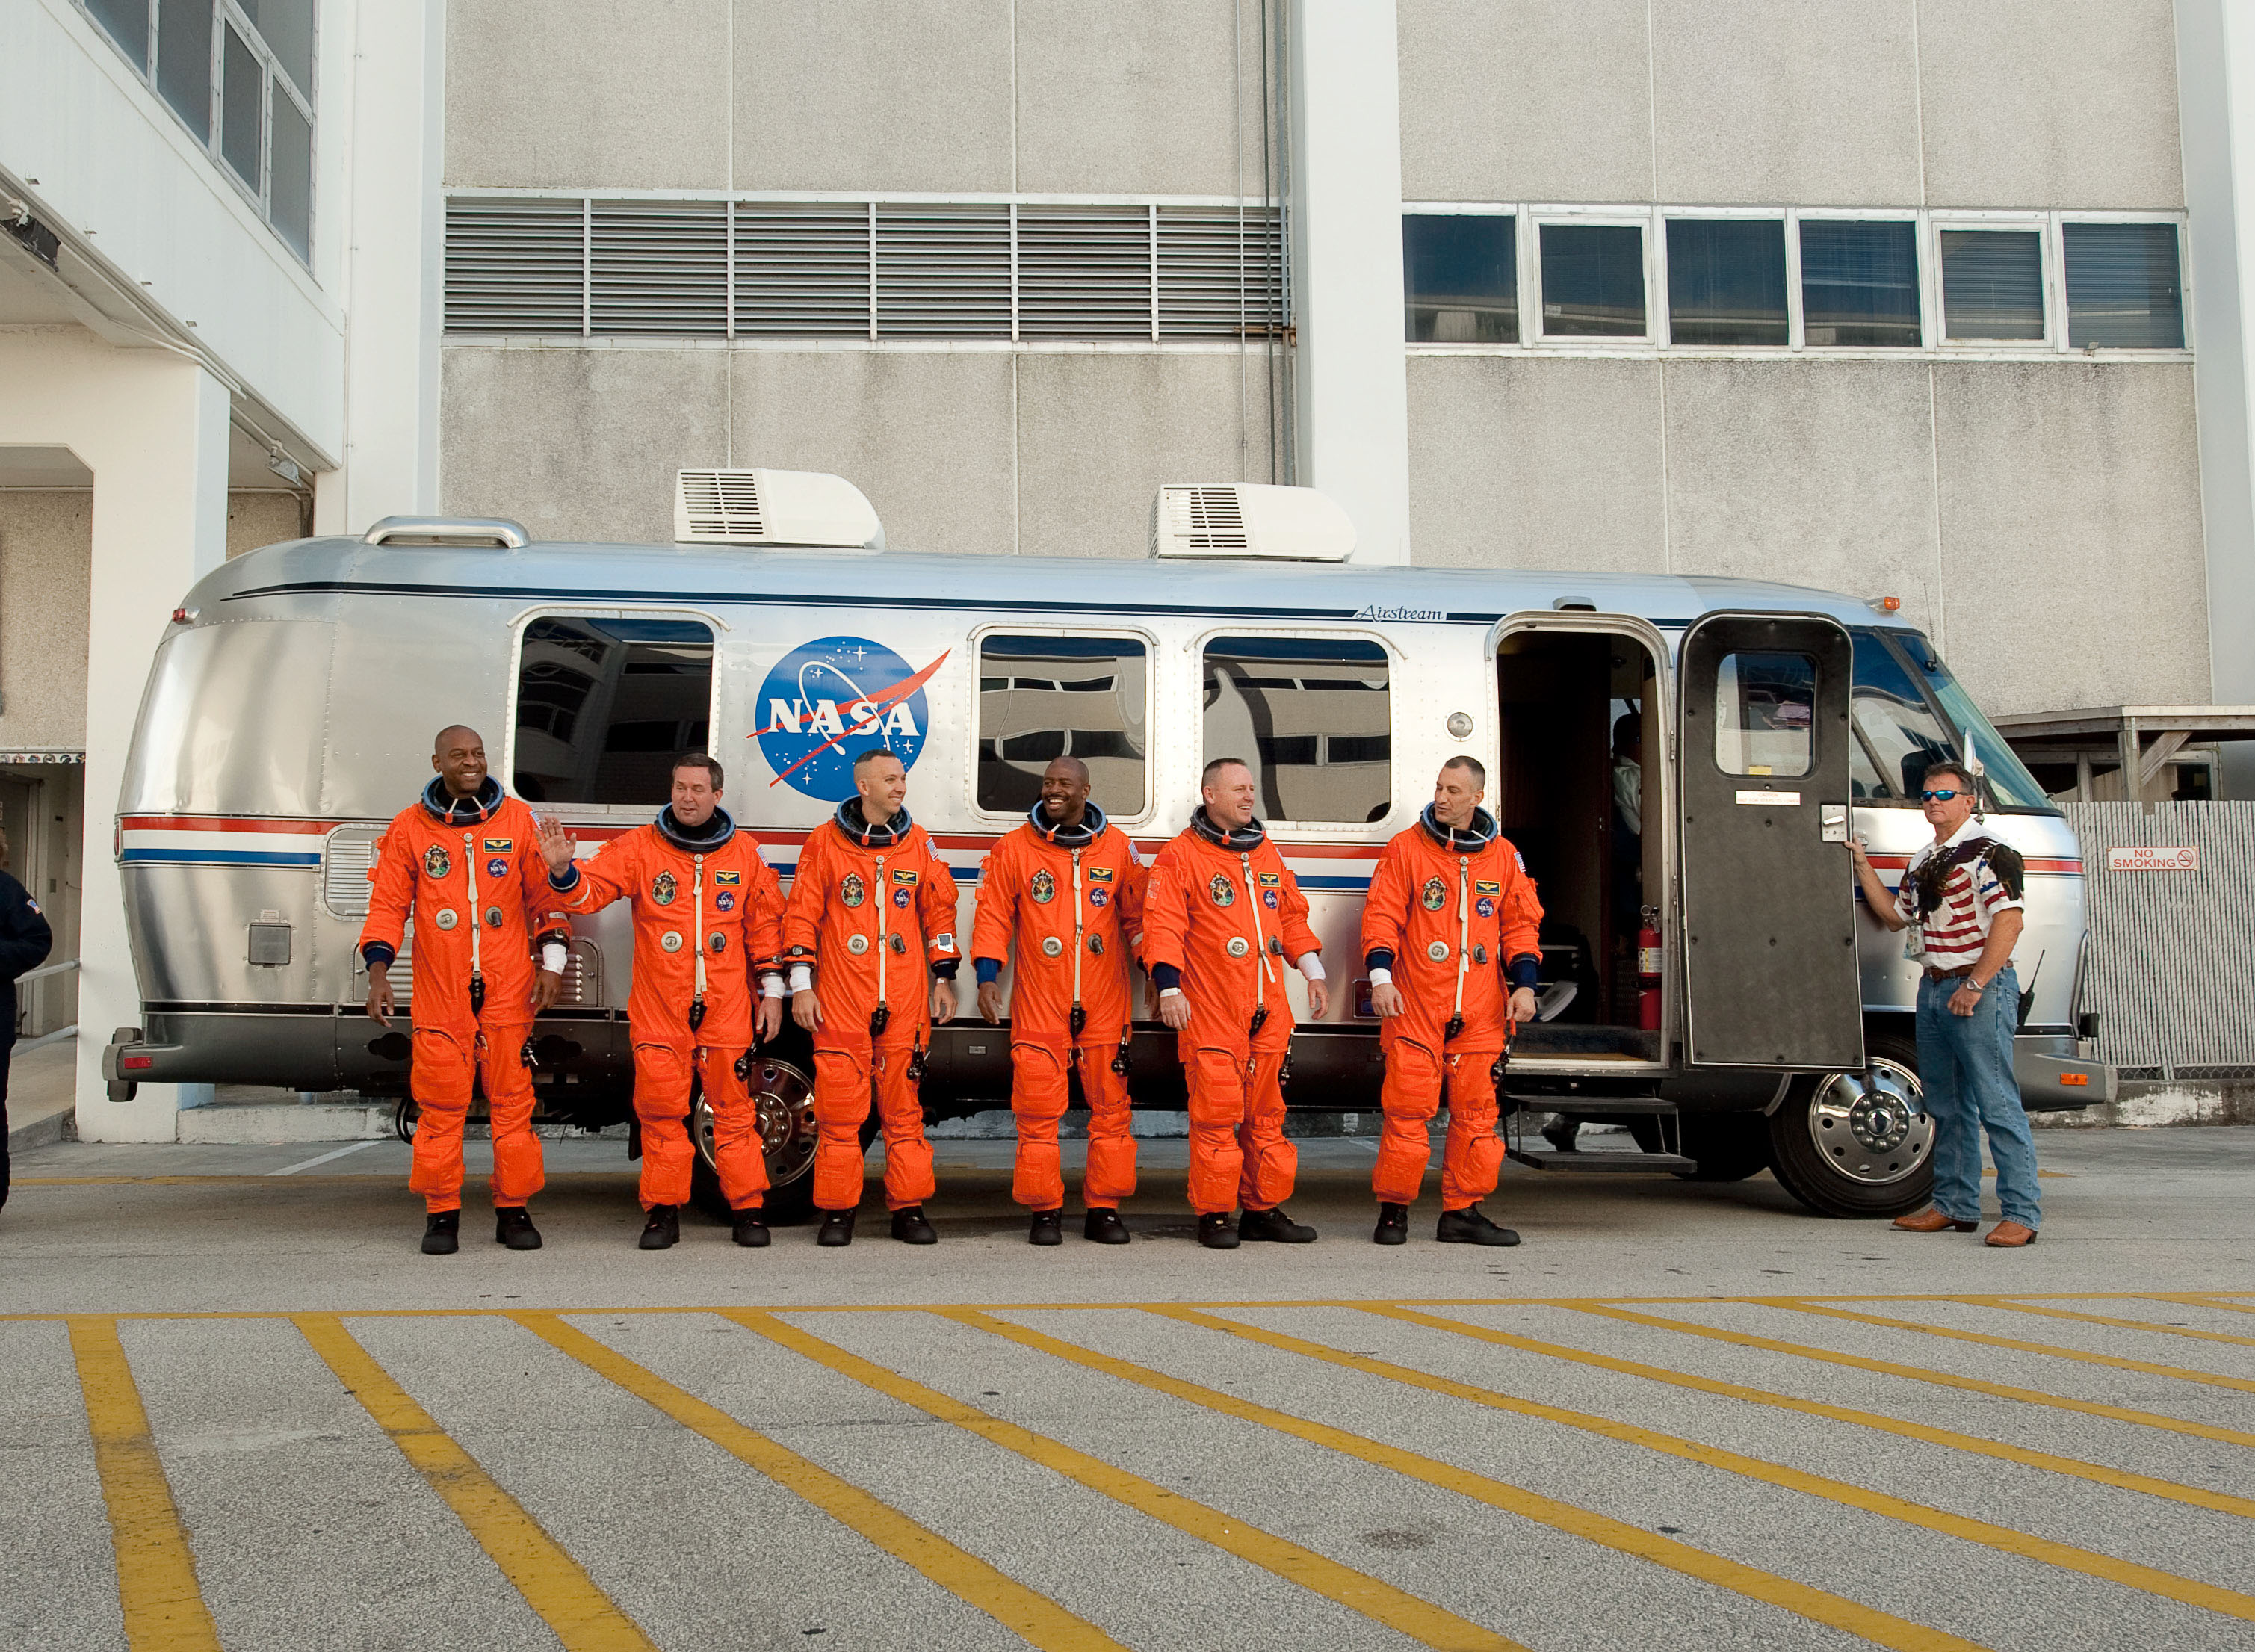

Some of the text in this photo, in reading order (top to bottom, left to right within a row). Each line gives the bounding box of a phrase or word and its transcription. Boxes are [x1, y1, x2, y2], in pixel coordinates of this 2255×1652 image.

[1356, 604, 1443, 622] Airstream
[767, 698, 921, 736] NASA
[2135, 849, 2153, 858] NO
[2114, 859, 2176, 867] SMOKING
